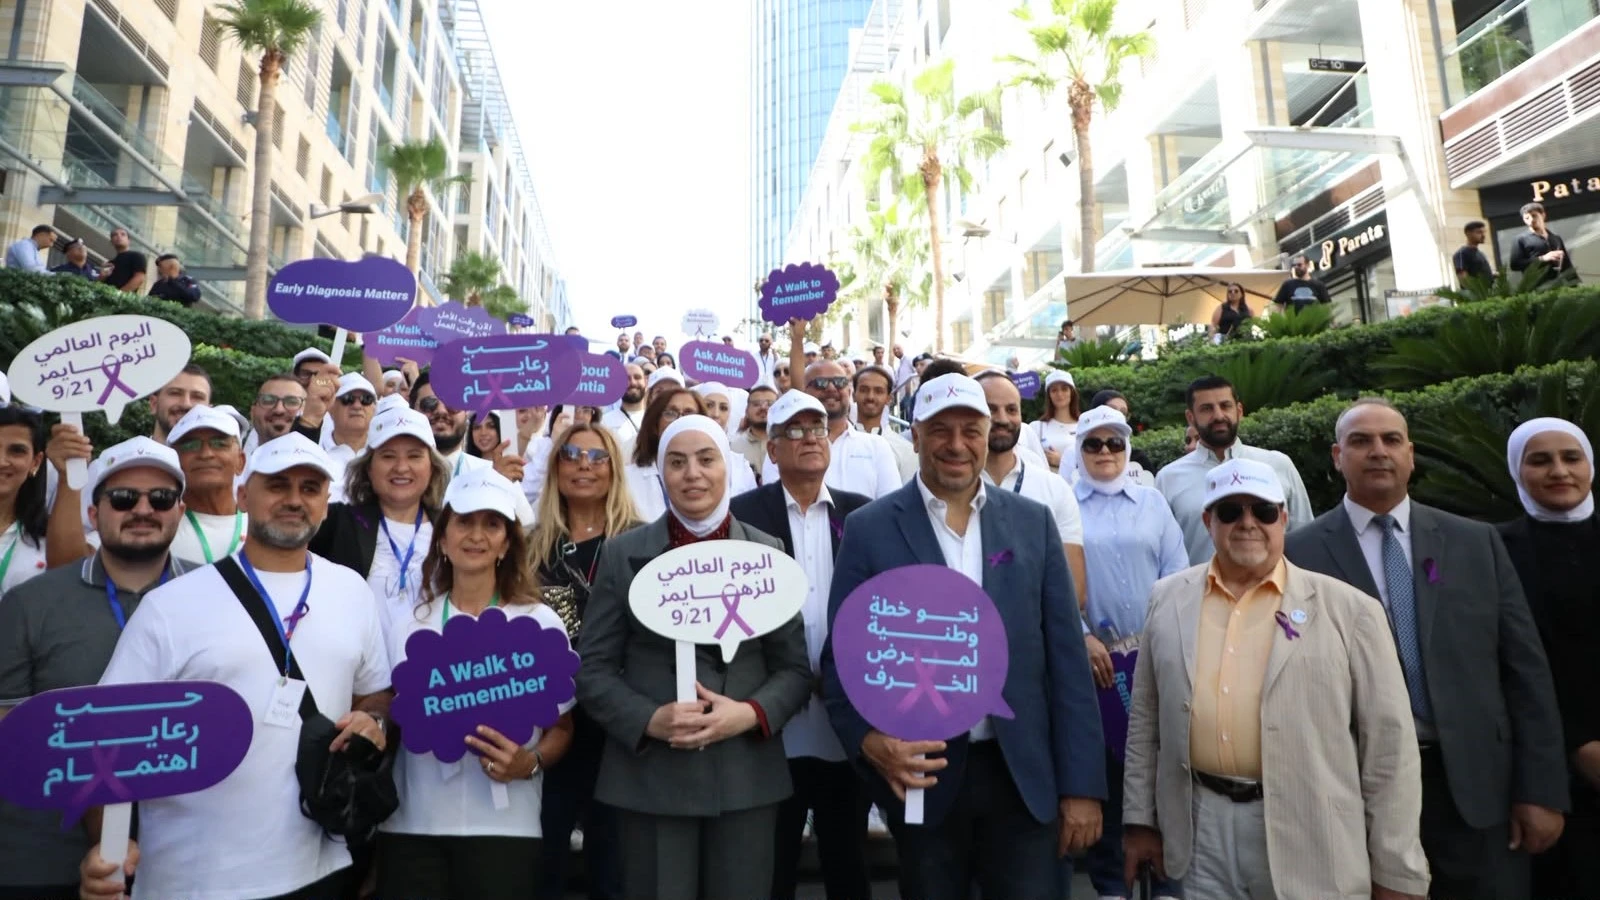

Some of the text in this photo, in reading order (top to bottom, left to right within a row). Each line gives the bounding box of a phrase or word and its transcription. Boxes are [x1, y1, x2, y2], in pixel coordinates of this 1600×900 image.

[275, 283, 408, 300] Early Diagnosis Matters
[772, 290, 824, 306] Remember
[775, 279, 821, 294] A Walk to
[378, 335, 438, 348] Remember
[395, 323, 421, 335] Walk
[34, 322, 151, 366] اليوم العالمي
[462, 339, 549, 358] حب
[693, 348, 745, 366] Ask About
[38, 343, 156, 386] للزهايمر
[461, 356, 549, 375] رعاية
[696, 361, 744, 378] Dementia
[52, 378, 93, 399] 9/21
[463, 375, 550, 403] اهتمام
[577, 380, 605, 393] ntia
[657, 553, 772, 586] اليوم العالمي
[658, 578, 775, 607] للزهايمر
[671, 607, 711, 625] 9/21
[869, 595, 979, 623] نحو خطة
[867, 615, 979, 648] وطنية
[866, 643, 979, 667] لمرض
[428, 651, 535, 689] A Walk to
[864, 665, 978, 693] الخرف
[55, 691, 203, 722] حب
[423, 675, 547, 716] Remember
[47, 717, 199, 749] رعاية
[43, 746, 198, 796] اهتمام
